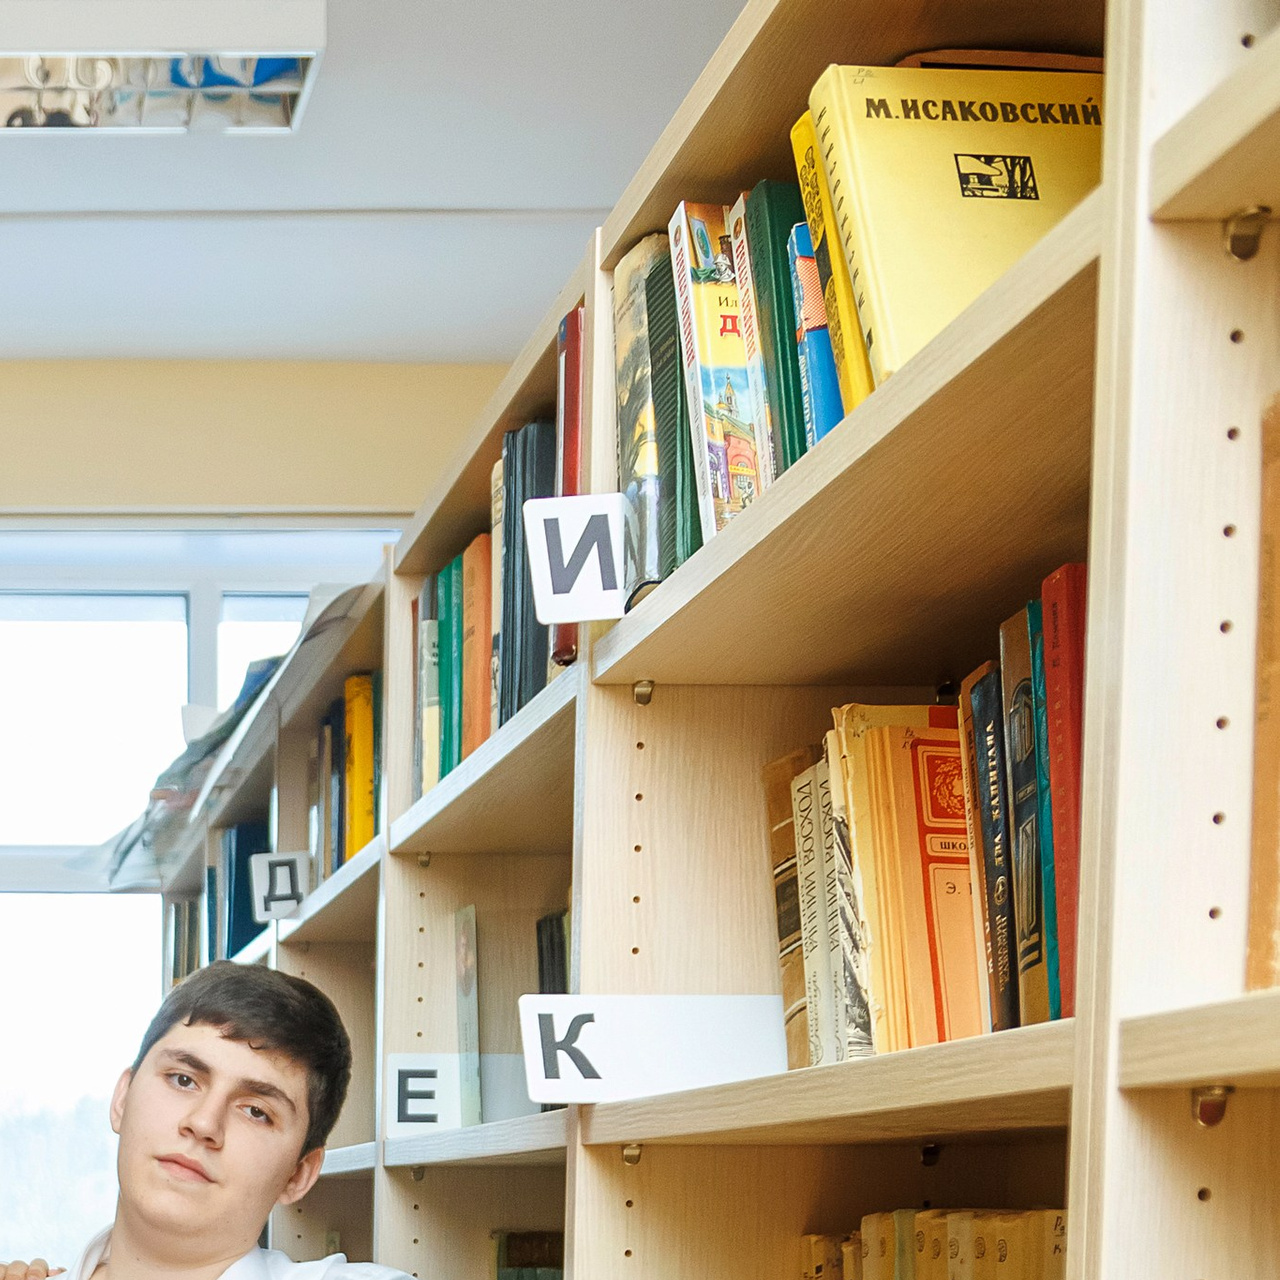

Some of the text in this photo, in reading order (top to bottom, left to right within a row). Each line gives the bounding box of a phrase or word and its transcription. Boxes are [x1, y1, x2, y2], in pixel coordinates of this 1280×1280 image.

[866, 97, 1102, 127] М.ИСАКОВСКИЙ
[718, 296, 738, 308] Ил
[543, 513, 618, 595] И
[797, 779, 815, 867] ВОСХОД
[986, 720, 1004, 866] ДВА КАПИТАНА
[939, 840, 968, 852] ШКО
[262, 857, 304, 912] Д
[805, 871, 818, 953] РАННИЙ
[825, 869, 839, 953] РАННИЙ
[538, 1013, 603, 1081] К
[396, 1068, 440, 1124] Е
